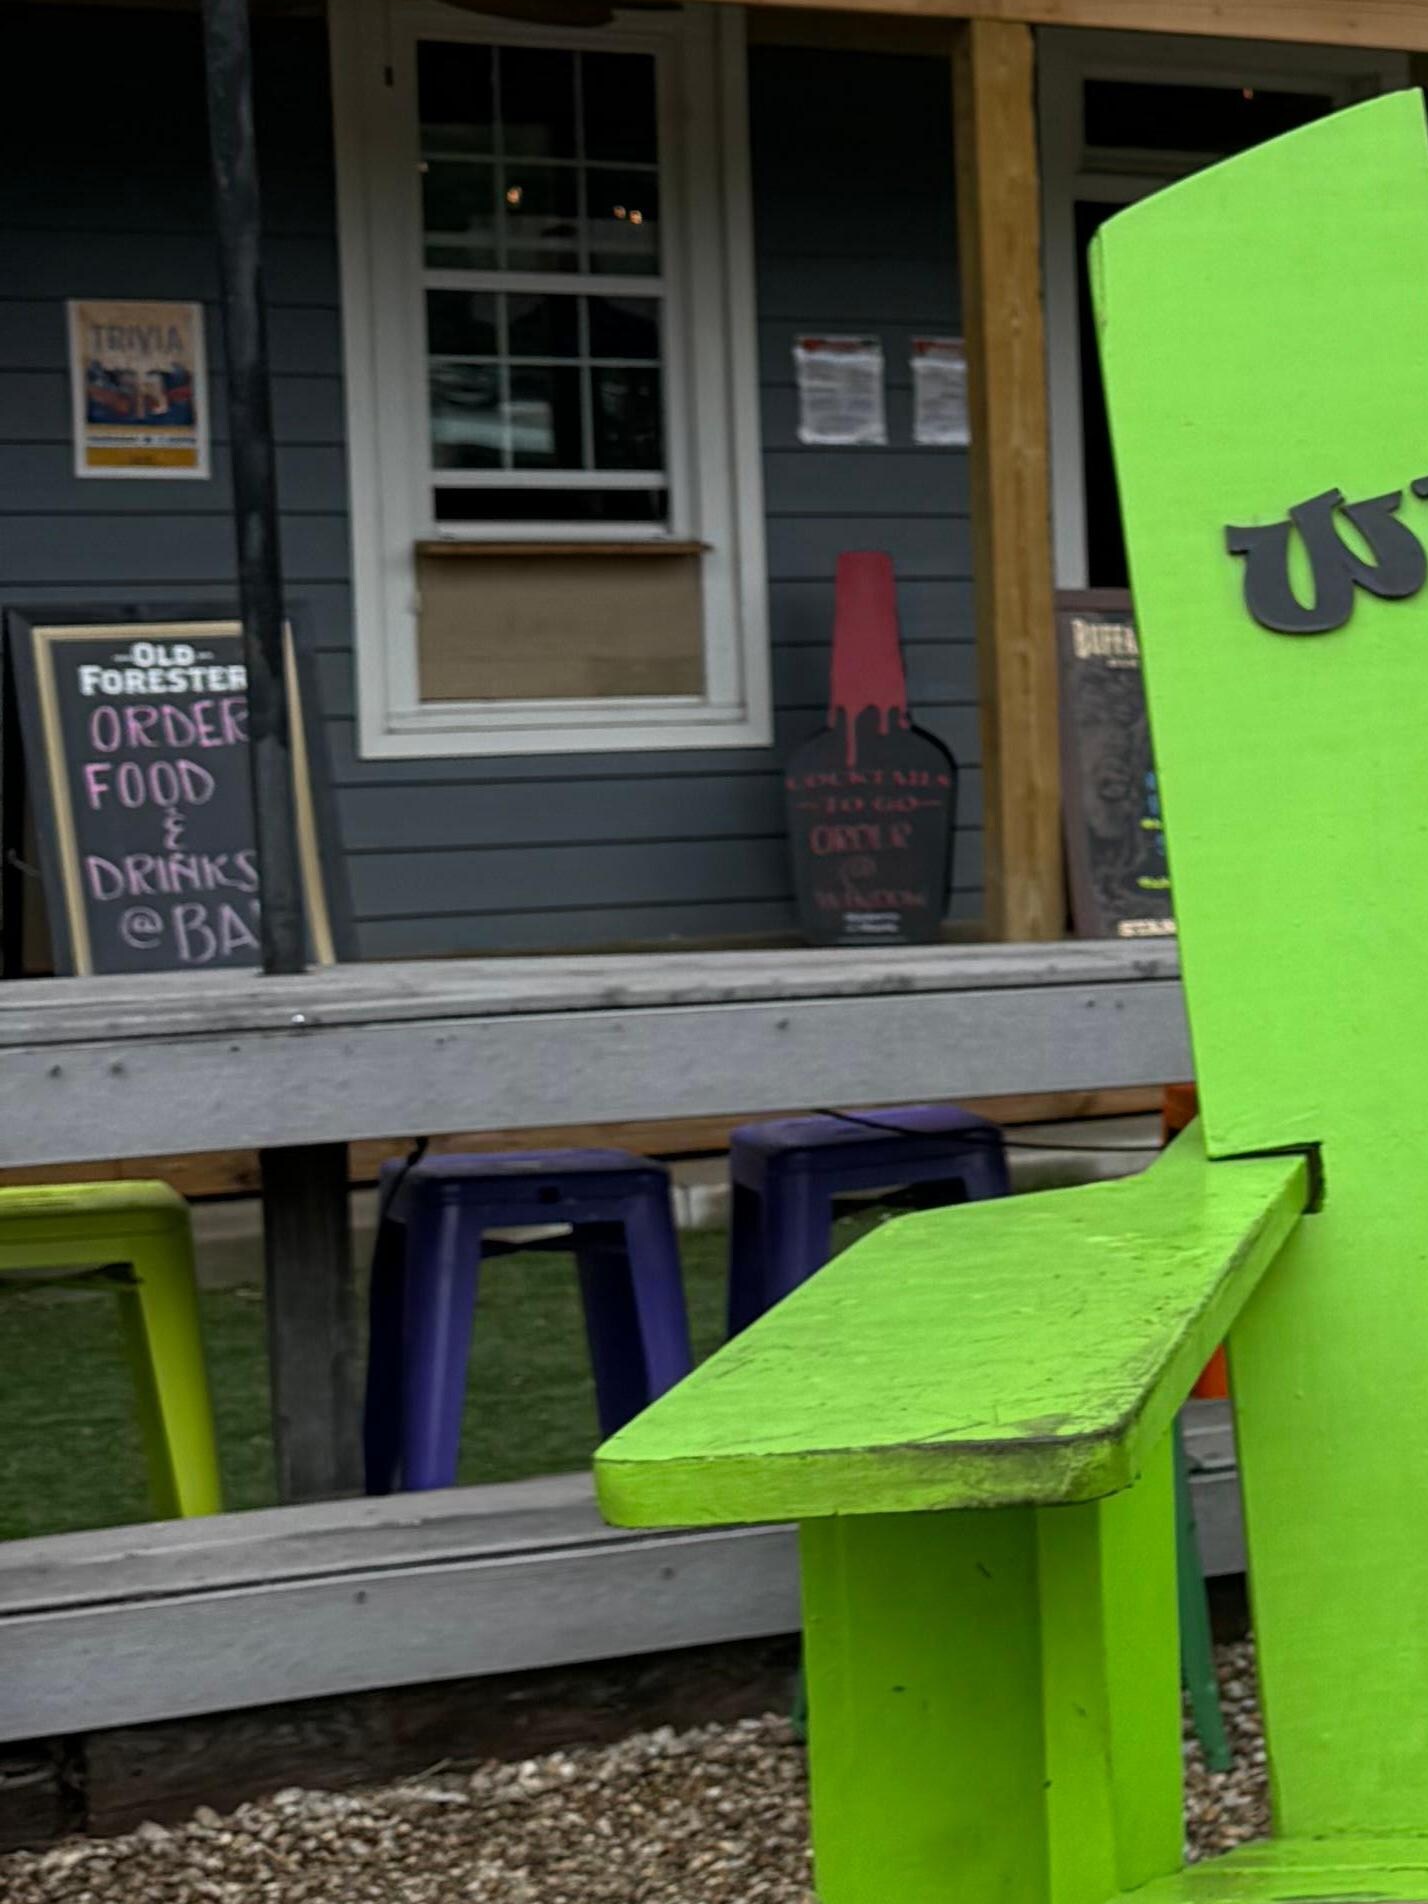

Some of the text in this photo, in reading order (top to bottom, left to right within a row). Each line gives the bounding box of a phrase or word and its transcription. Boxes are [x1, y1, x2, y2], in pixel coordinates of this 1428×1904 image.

[90, 324, 184, 354] TRIVIA
[130, 642, 196, 669] OLD
[78, 664, 248, 696] FORESTER
[91, 696, 250, 753] ORDER
[84, 758, 215, 810] FOOD
[86, 848, 260, 900] DRINKS
